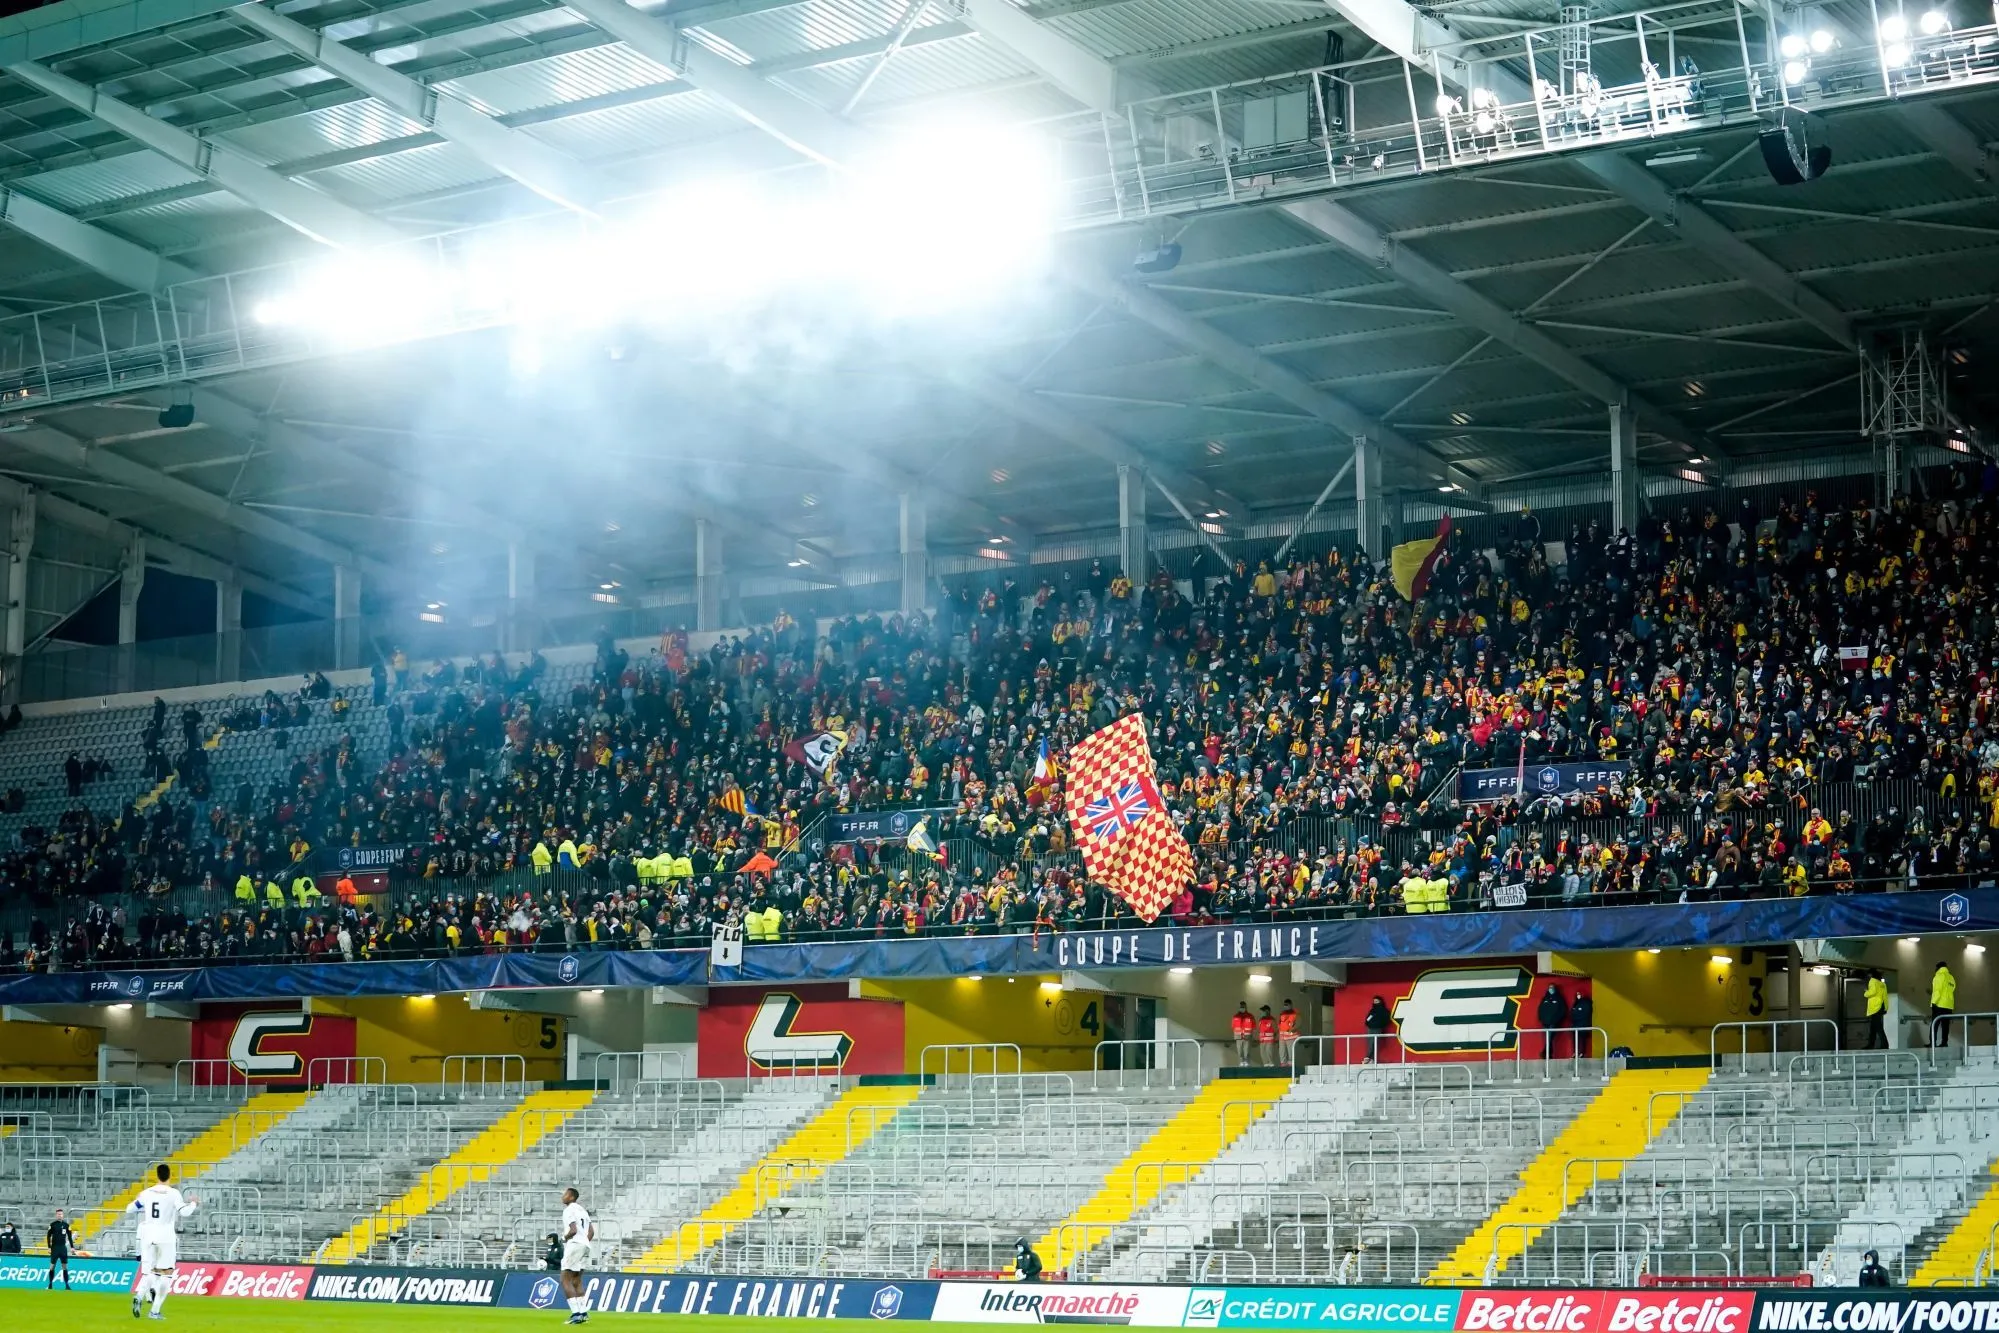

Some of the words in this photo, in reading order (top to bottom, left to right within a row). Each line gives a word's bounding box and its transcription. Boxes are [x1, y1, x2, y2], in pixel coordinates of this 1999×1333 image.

[1478, 777, 1517, 789] FFF.F
[842, 821, 878, 832] FFF.FR
[1059, 934, 1139, 966] COUPE
[1163, 932, 1191, 961] DE
[1217, 926, 1319, 960] FRANCE
[1749, 976, 1764, 1016] 3
[540, 1017, 557, 1050] 5
[744, 991, 855, 1069] L
[1080, 1001, 1099, 1036] 4
[151, 1201, 160, 1219] 6
[0, 1265, 49, 1281] CRÉDIT
[222, 1268, 304, 1298] Betclic
[312, 1274, 494, 1304] NIKE.COM/FOOTBALL
[583, 1277, 671, 1314] COUPE
[680, 1281, 718, 1315] DE
[729, 1281, 845, 1319] FRANCE
[980, 1288, 1140, 1323] Intermarché
[1225, 1297, 1317, 1320] CRÉDIT
[1320, 1303, 1451, 1323] AGRICOLE
[1463, 1295, 1592, 1331] Betclic
[1608, 1295, 1742, 1333] Betclic
